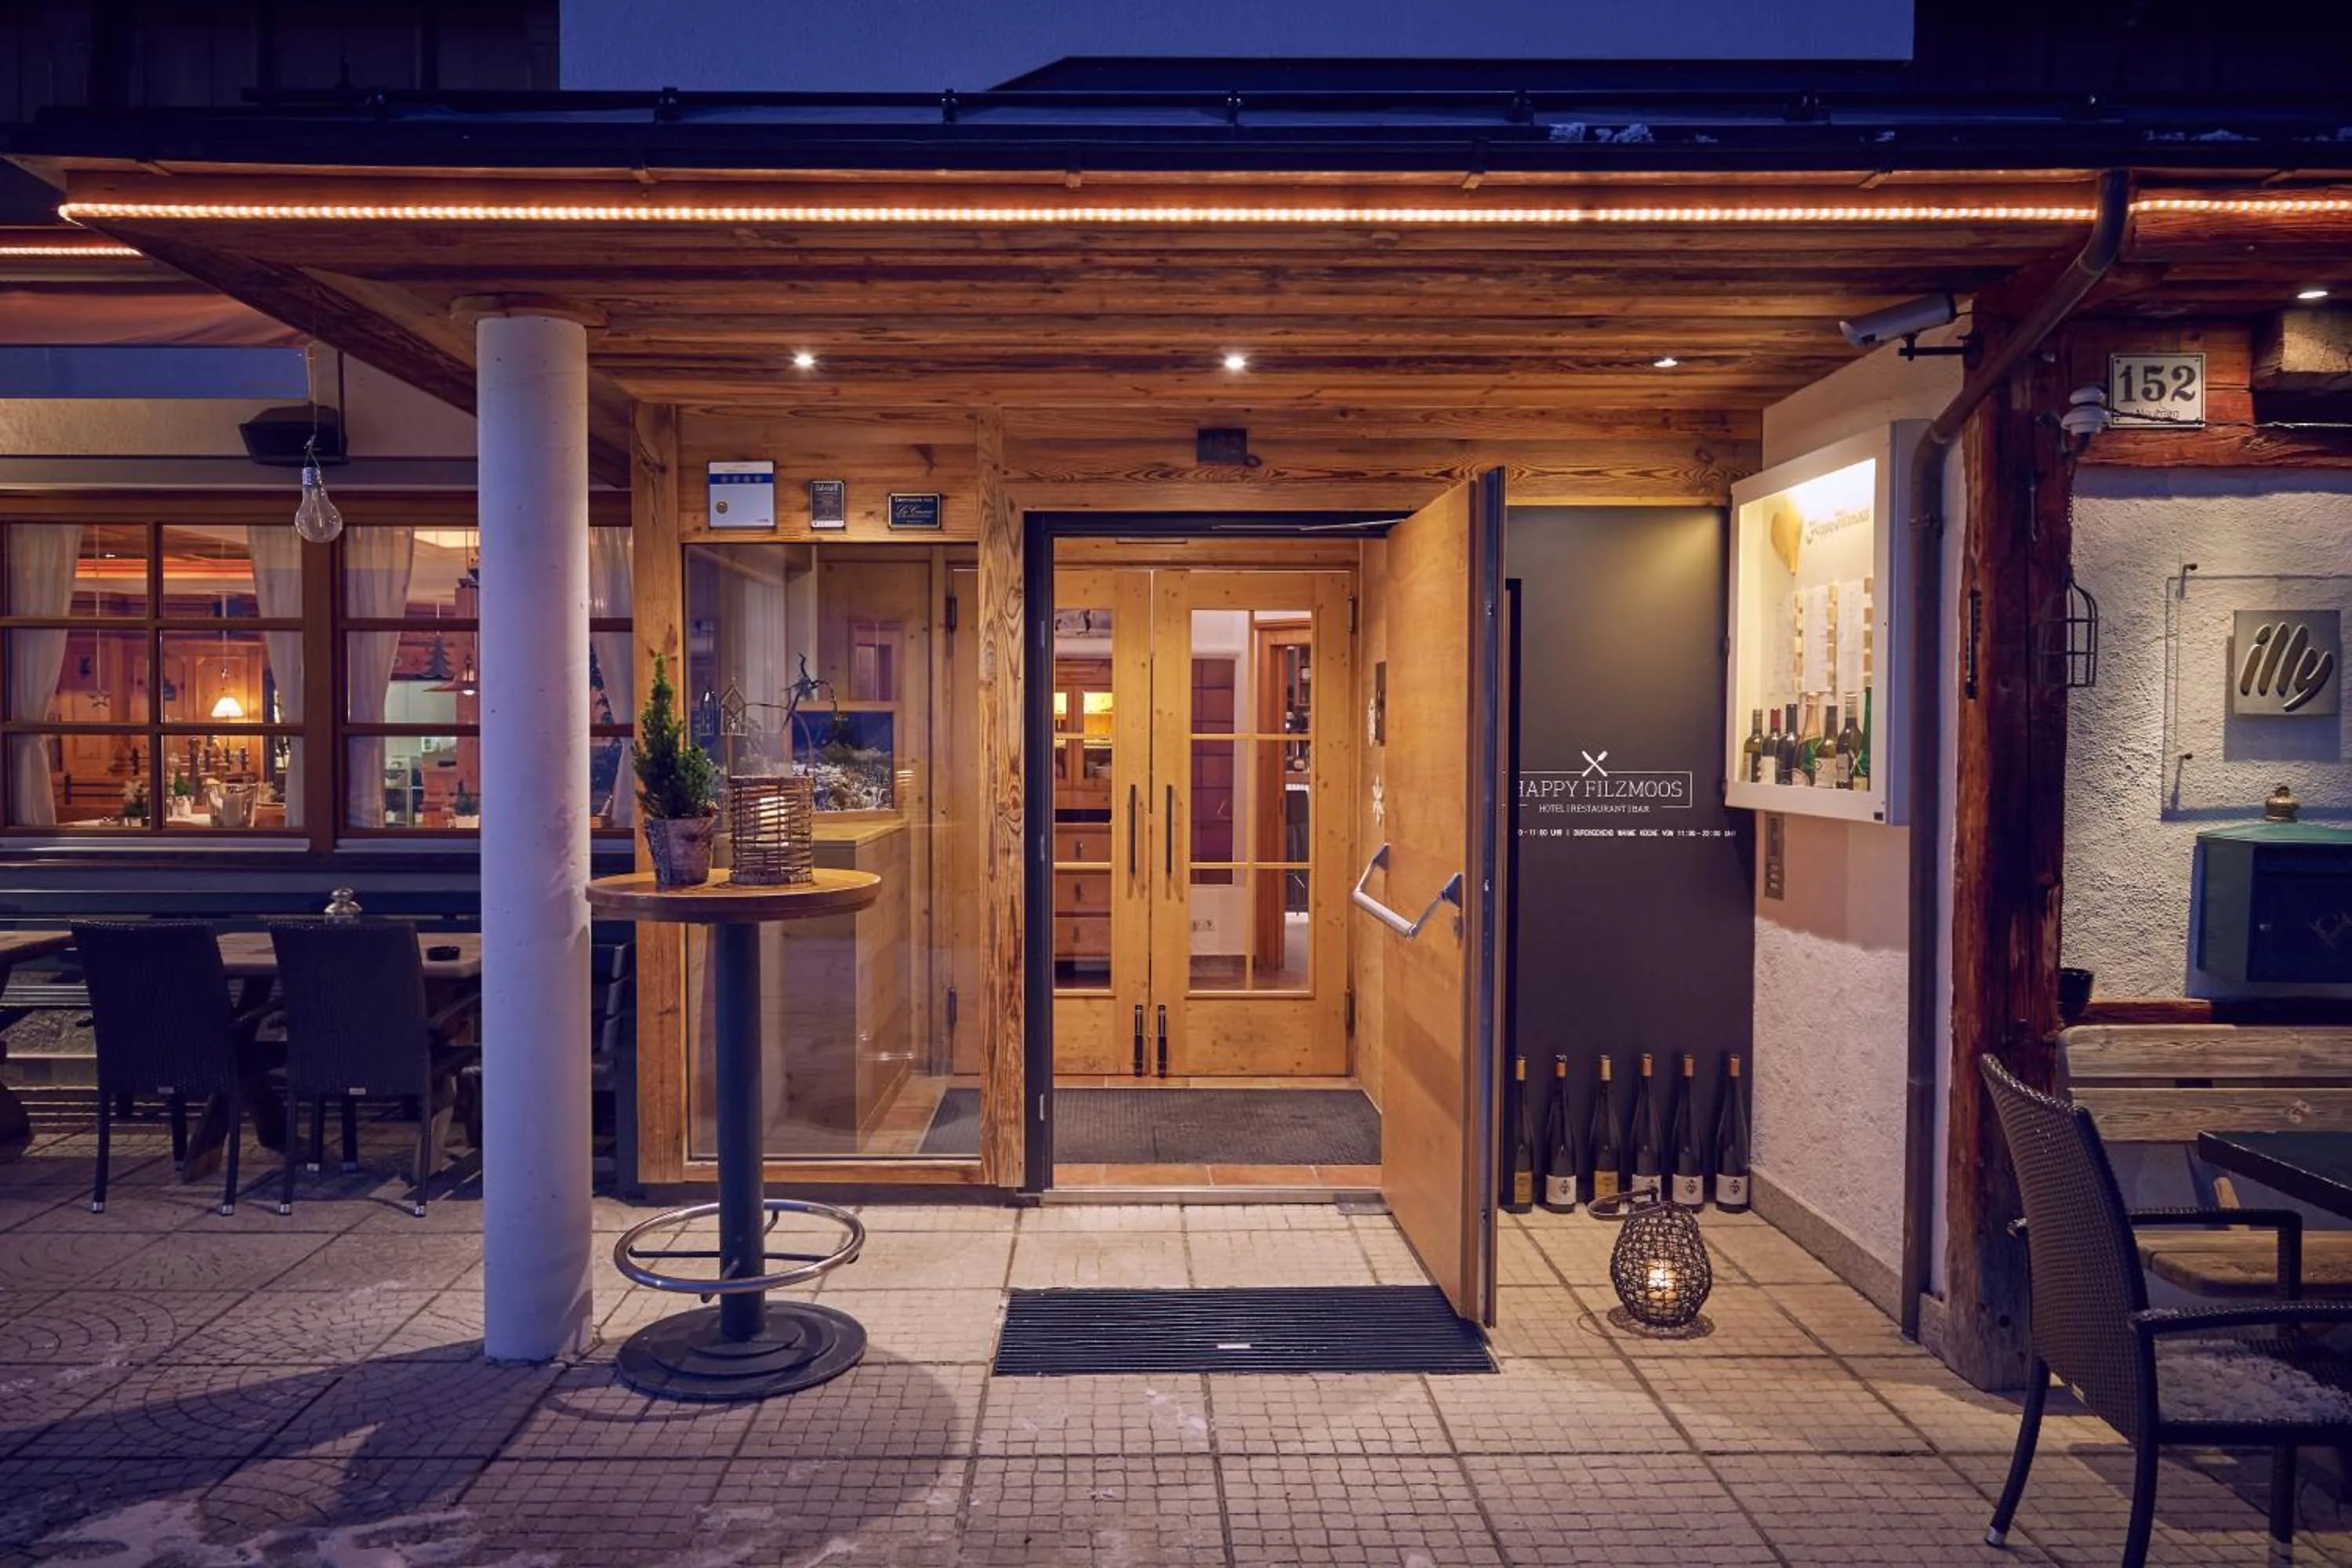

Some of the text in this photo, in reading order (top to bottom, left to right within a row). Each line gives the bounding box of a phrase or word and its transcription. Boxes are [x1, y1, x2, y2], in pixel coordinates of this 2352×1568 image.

[2119, 365, 2196, 402] 152
[2240, 621, 2334, 712] illy
[1584, 780, 1683, 797] FILZMOOS
[1539, 804, 1565, 813] HOTEL
[1570, 804, 1626, 813] RESTAURANT
